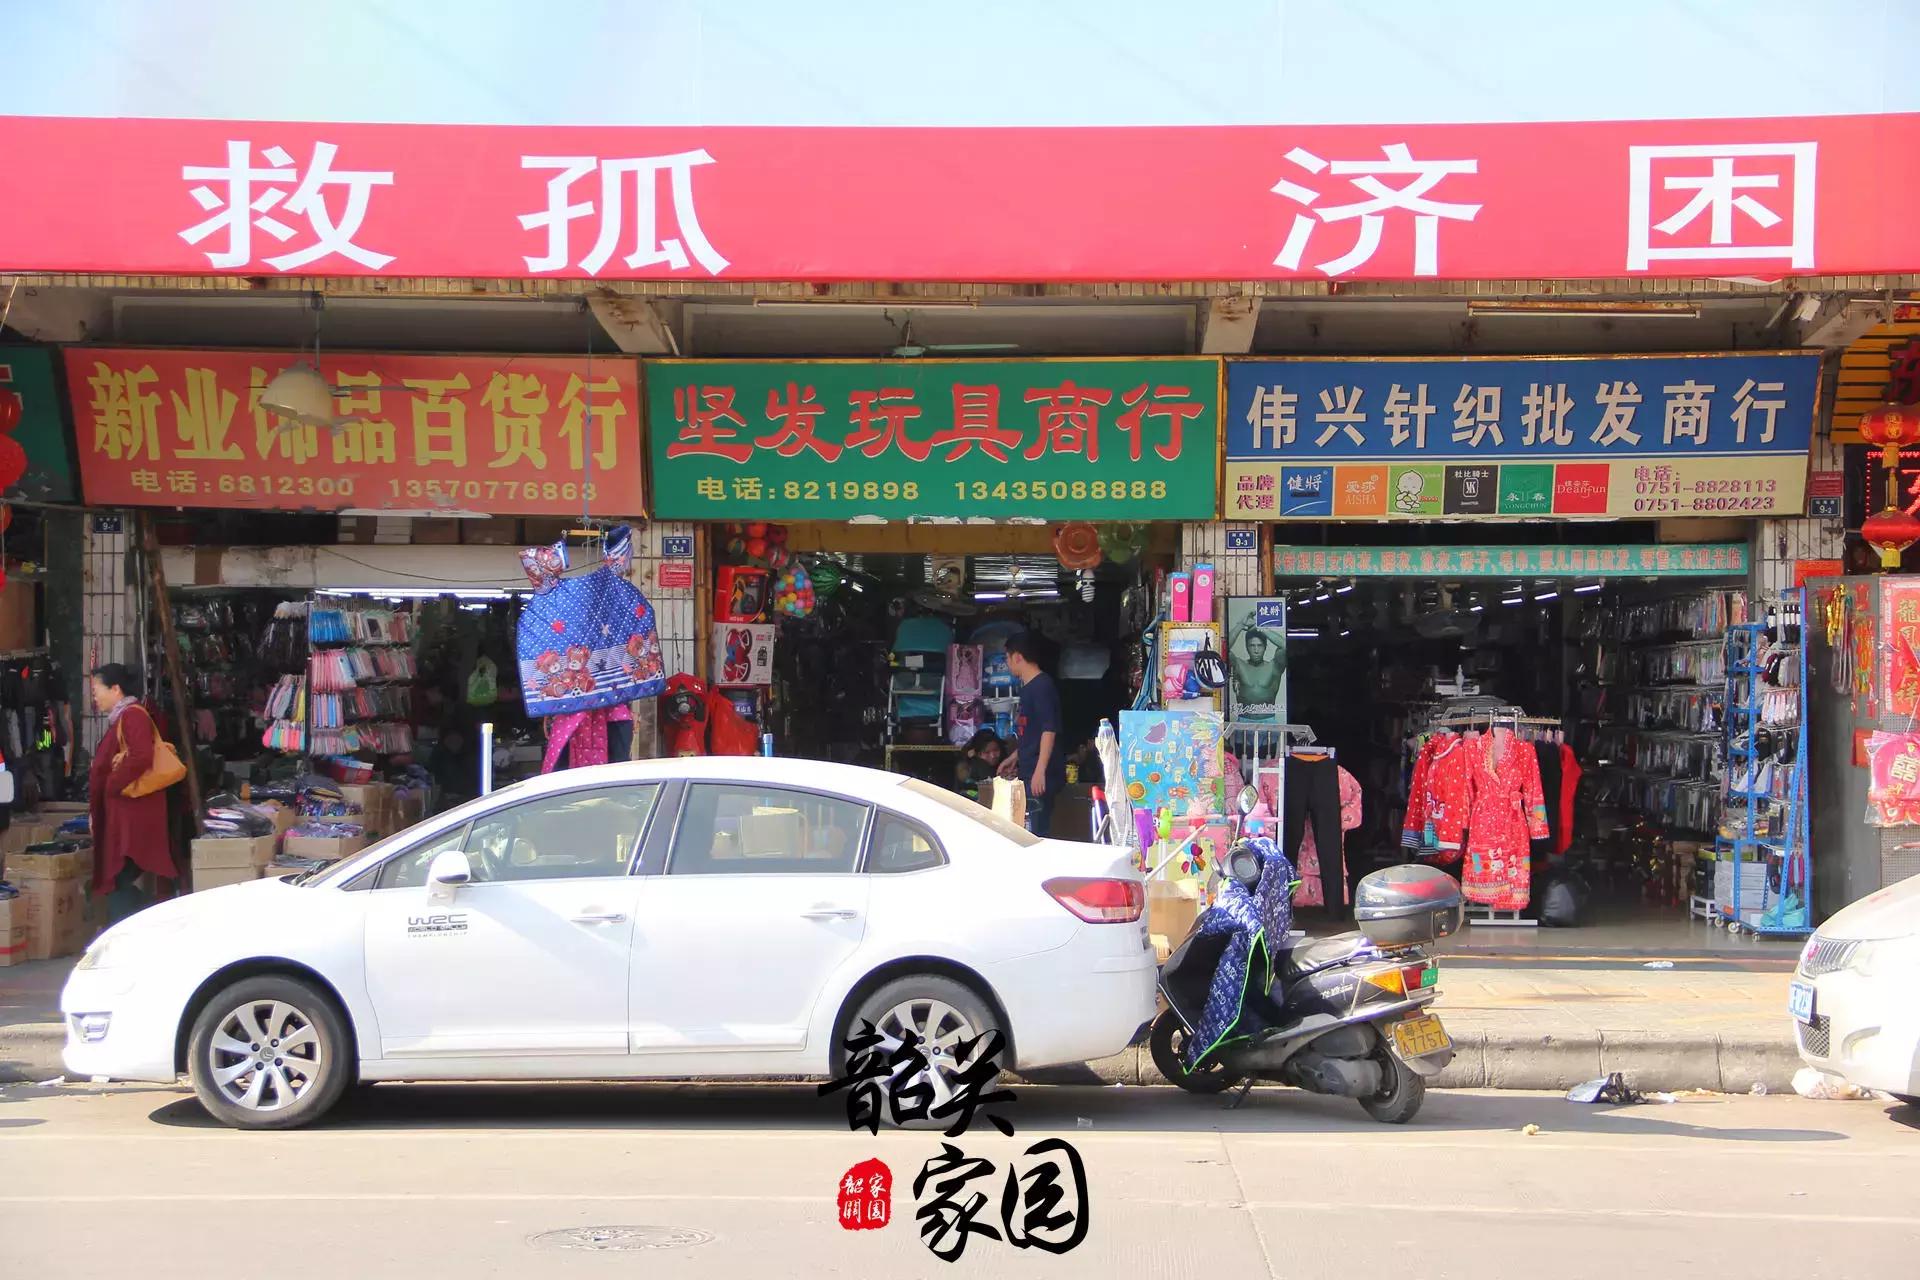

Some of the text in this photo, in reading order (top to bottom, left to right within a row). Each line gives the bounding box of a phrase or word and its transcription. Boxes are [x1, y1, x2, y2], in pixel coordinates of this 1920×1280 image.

[177, 140, 1818, 278] 救孤 济困
[87, 361, 628, 470] 新业饰品百货行
[666, 379, 1204, 464] 坚发玩具商行
[1246, 378, 1787, 449] 伟兴针织批发商行
[388, 478, 598, 502] 13570776863
[955, 480, 1167, 501] 13435088888
[1237, 474, 1276, 491] 品牌
[1236, 493, 1275, 510] 代理
[1345, 494, 1377, 505] AISHA
[1819, 505, 1832, 514] 9-2
